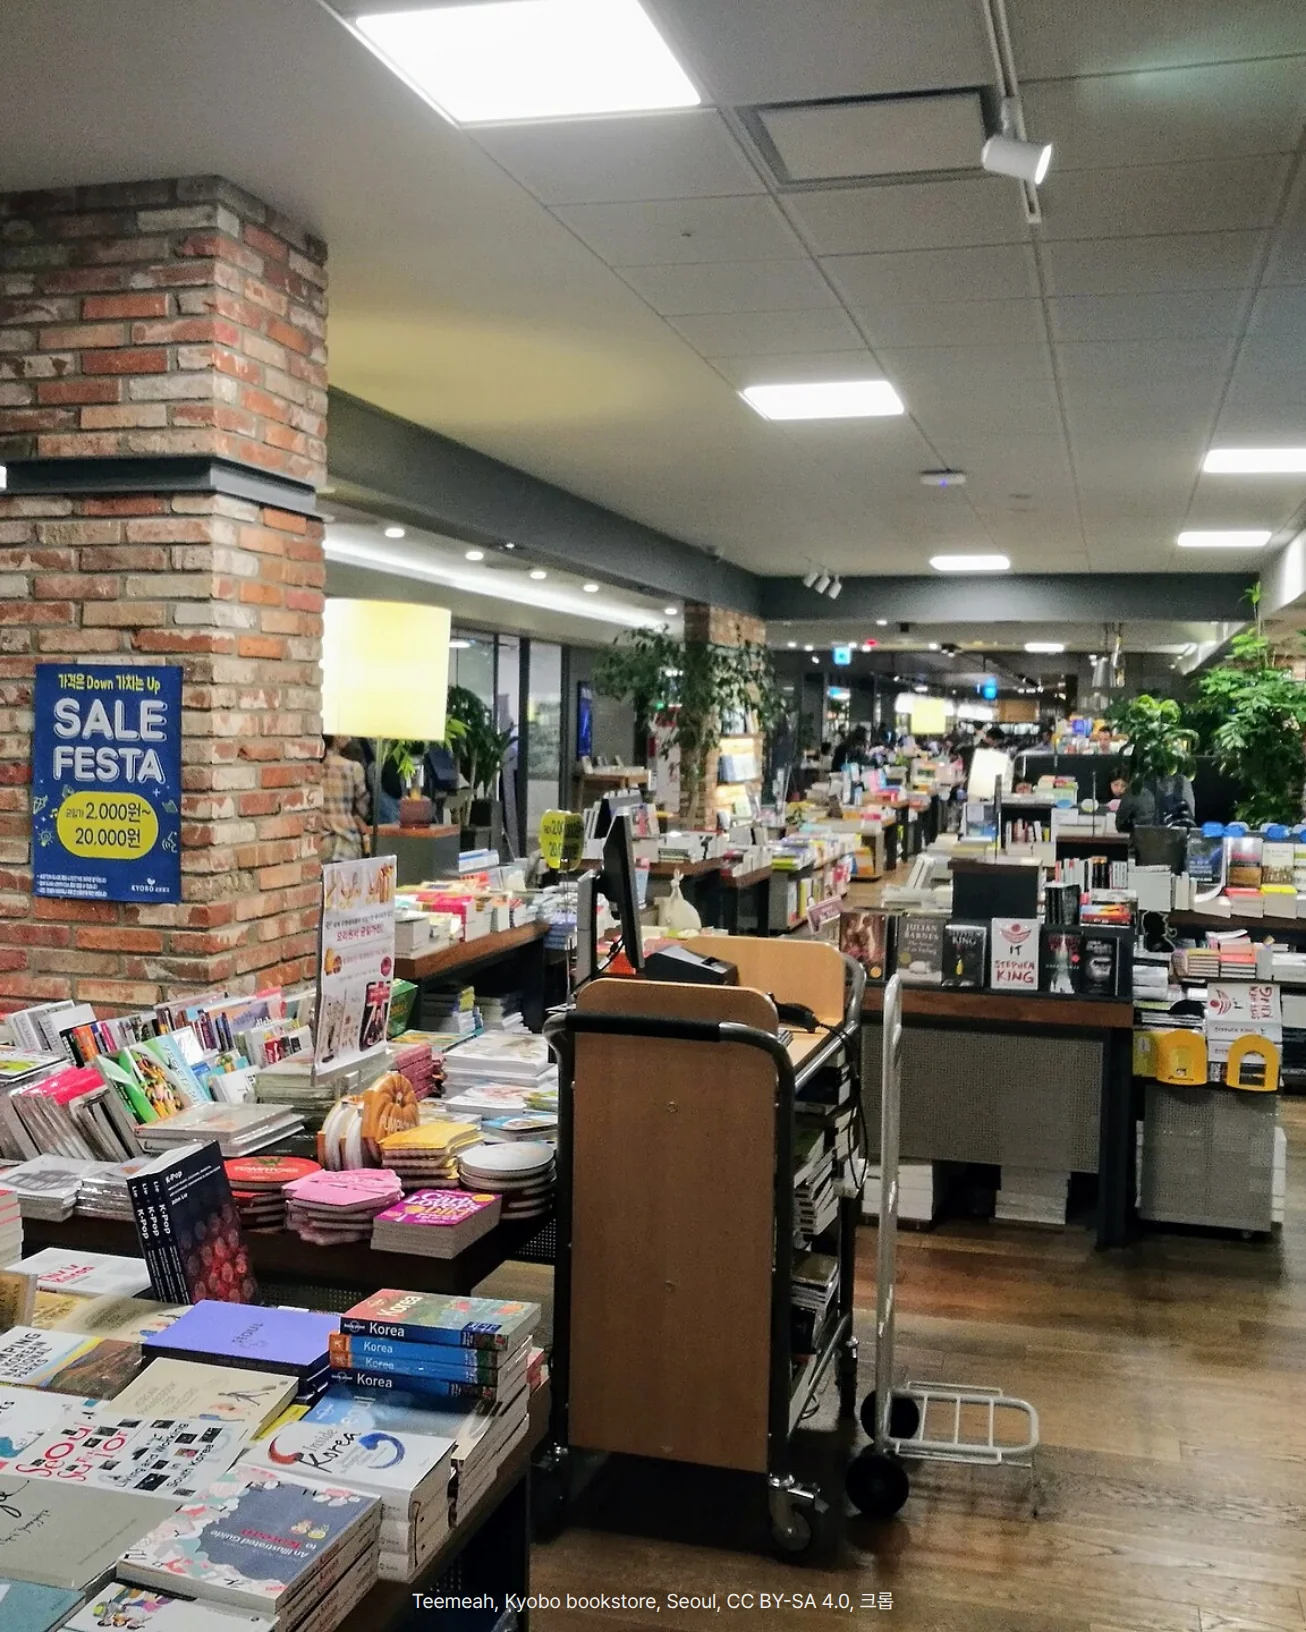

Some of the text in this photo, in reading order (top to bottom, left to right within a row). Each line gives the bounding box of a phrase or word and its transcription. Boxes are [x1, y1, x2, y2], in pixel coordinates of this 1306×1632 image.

[58, 673, 161, 695] 가격은 Down 가치는 Up
[53, 697, 168, 742] SALE
[53, 745, 166, 785] FESTA
[75, 827, 141, 849] 20,000원
[906, 923, 938, 932] JULIAN
[904, 931, 939, 940] BARNES
[952, 936, 977, 945] KING
[1009, 944, 1023, 955] IT
[995, 960, 1035, 969] STEPHEN
[996, 970, 1034, 983] KING
[131, 1185, 139, 1198] Lie
[141, 1182, 149, 1196] Lie
[376, 1295, 424, 1317] Korea
[369, 1322, 405, 1337] Korea
[363, 1341, 393, 1354] Korea
[365, 1356, 395, 1369] Korea
[356, 1373, 393, 1388] Korea
[302, 1428, 338, 1452] Inside
[15, 1421, 97, 1477] Seoul
[298, 1432, 362, 1474] Korea
[140, 1453, 159, 1467] and
[166, 1444, 214, 1488] South Korea
[210, 1530, 310, 1559] An Illustrated Guide
[305, 1542, 317, 1551] to
